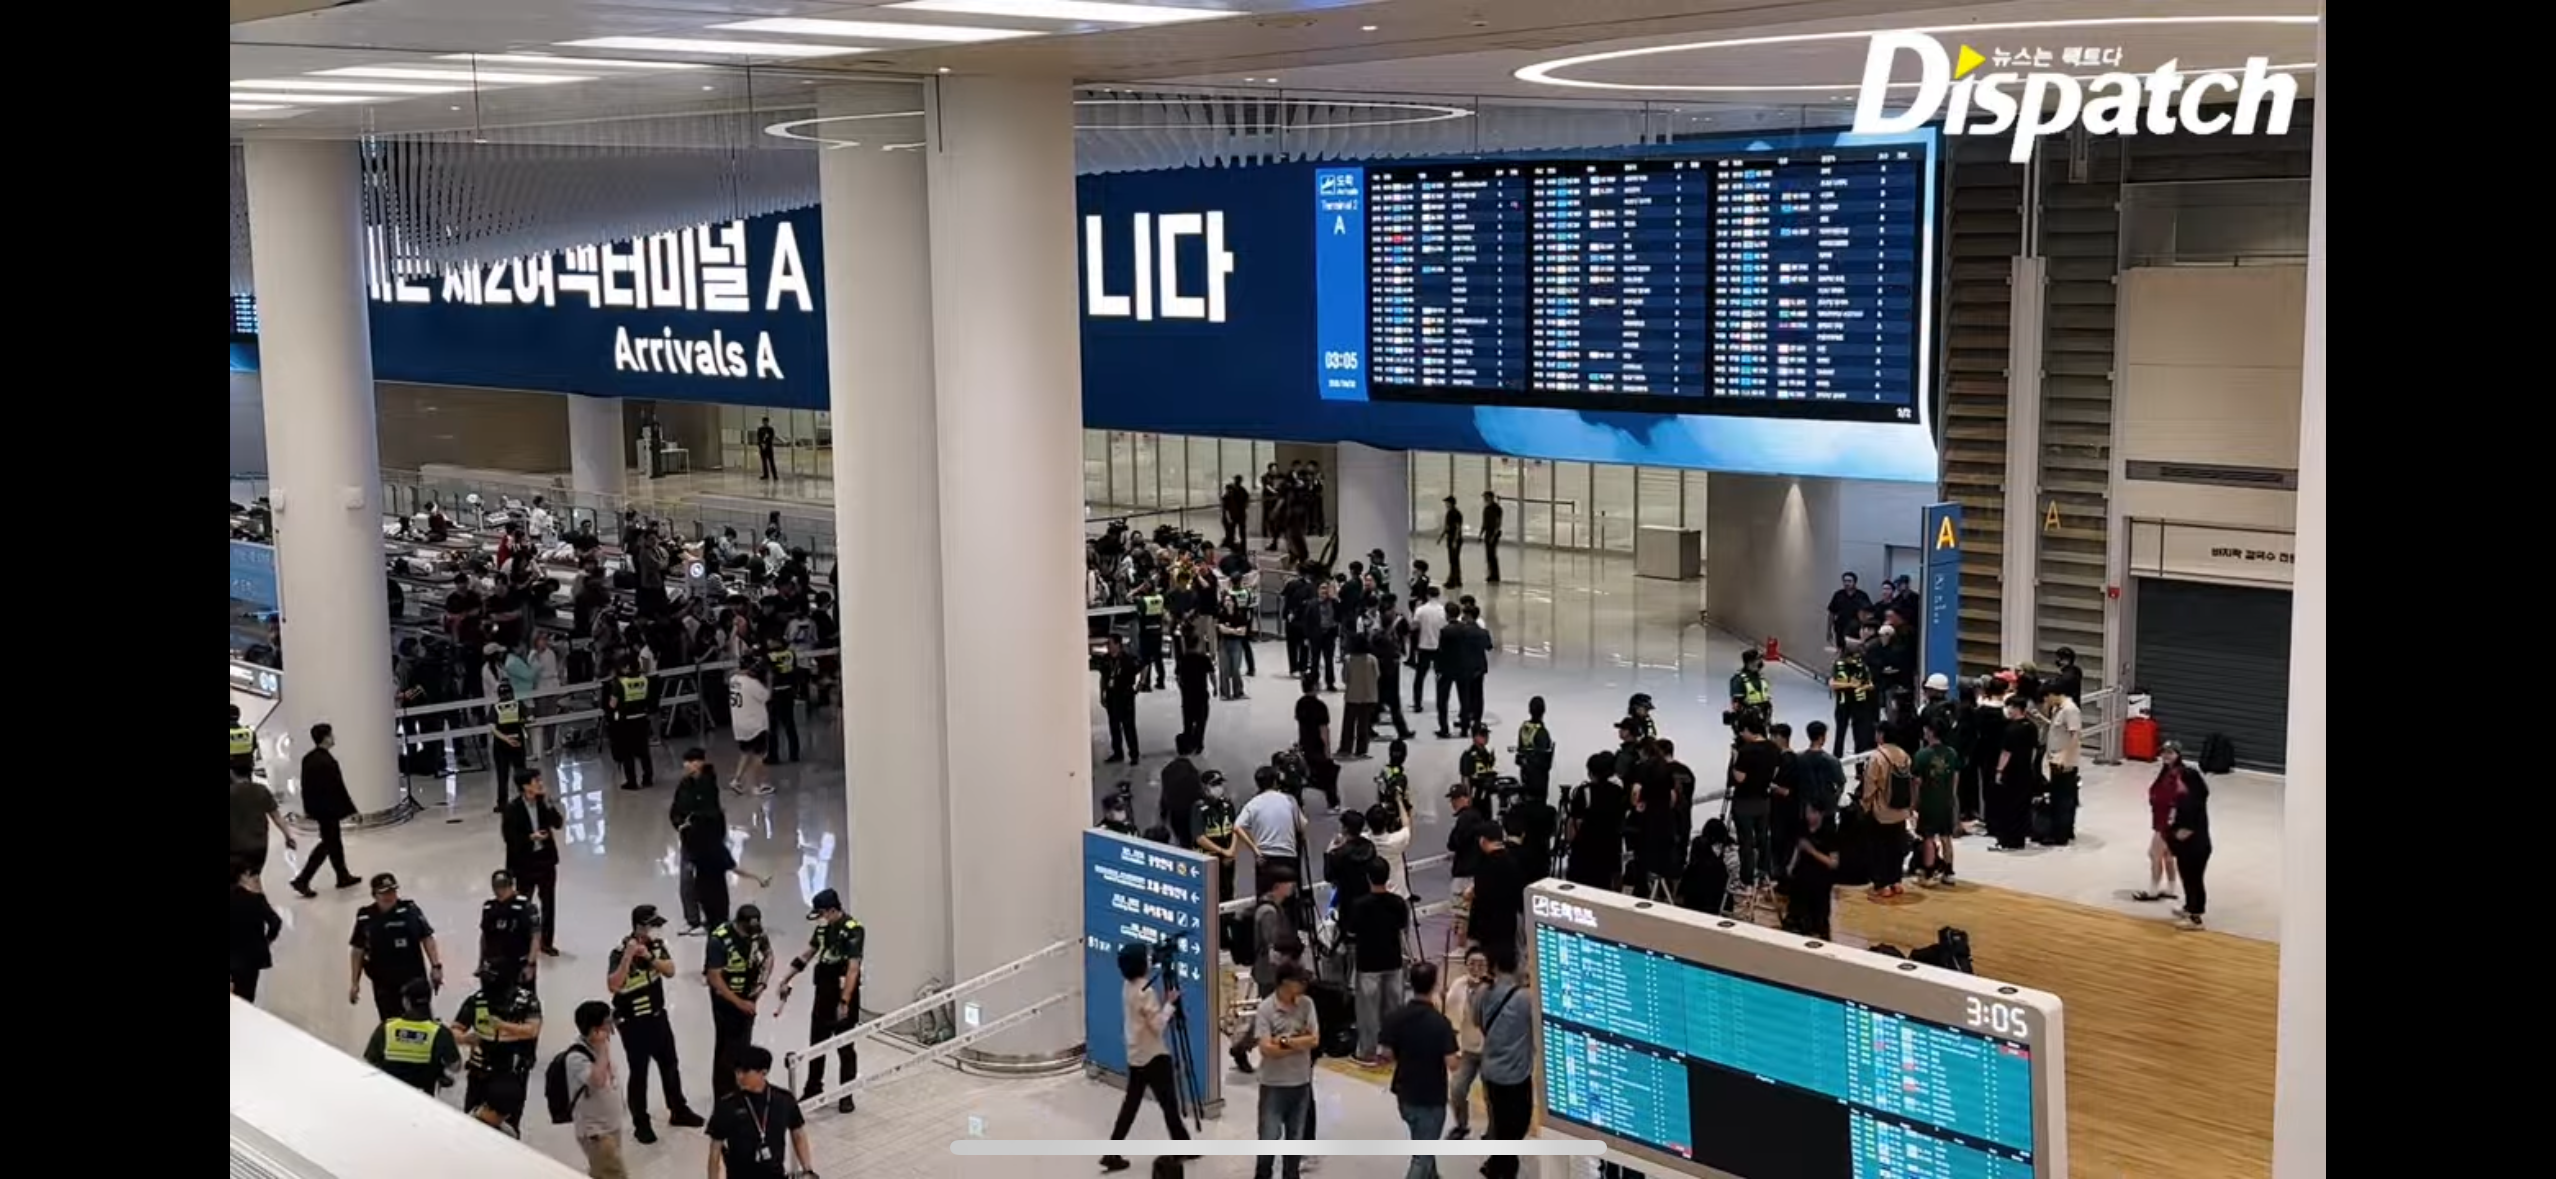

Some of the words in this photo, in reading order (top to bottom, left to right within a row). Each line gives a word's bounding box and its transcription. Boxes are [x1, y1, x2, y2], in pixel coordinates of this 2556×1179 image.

[1333, 214, 1346, 235] A
[765, 221, 814, 311] A
[614, 325, 748, 378] Arrivals
[756, 331, 785, 379] A
[1325, 351, 1358, 370] 03:05
[2044, 499, 2061, 531] A
[1936, 515, 1956, 550] A
[2211, 547, 2242, 559] 바지락
[1966, 996, 2028, 1039] 3:05
